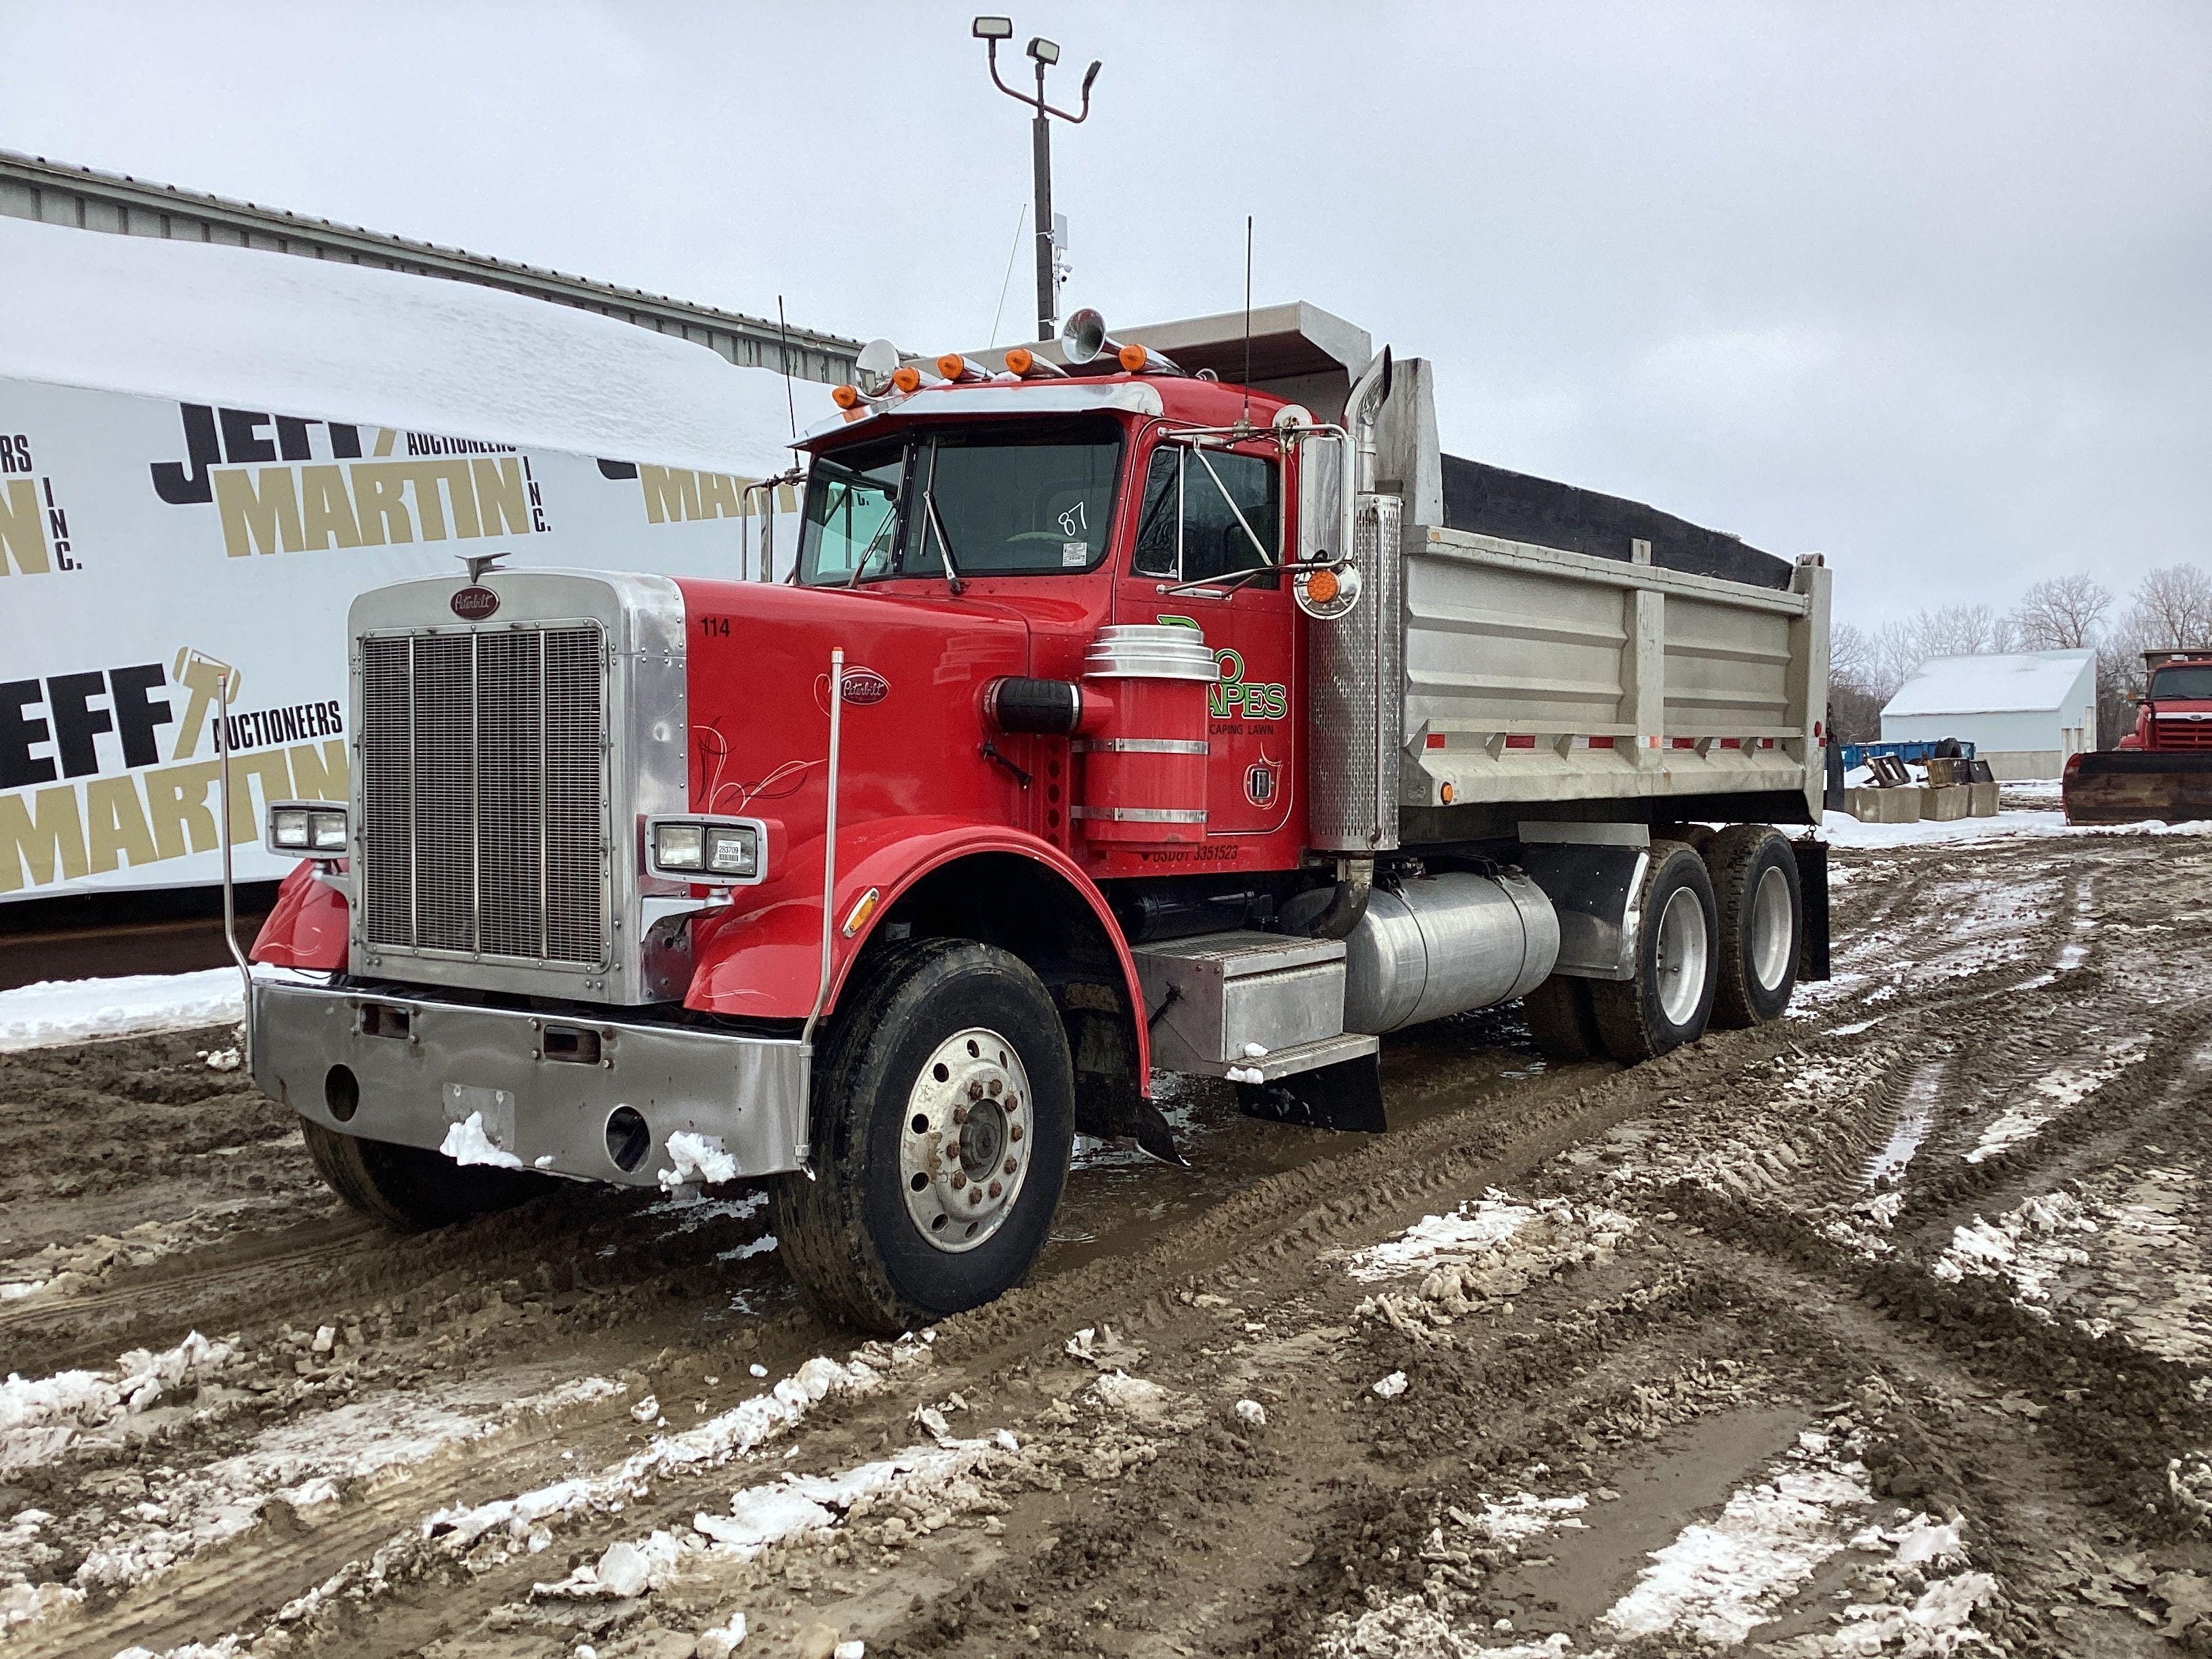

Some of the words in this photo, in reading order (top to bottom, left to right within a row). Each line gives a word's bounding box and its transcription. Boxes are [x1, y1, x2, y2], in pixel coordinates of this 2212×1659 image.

[213, 457, 530, 557] MARTIN
[1058, 501, 1087, 536] 87
[455, 594, 493, 611] Peterbilt
[701, 617, 730, 638] 114
[844, 680, 884, 696] Peterbilt
[1210, 682, 1287, 720] APES
[0, 663, 173, 789] EFF
[1209, 724, 1243, 735] CAPING
[1248, 724, 1274, 735] LAWN
[719, 846, 738, 854] 283709
[1193, 845, 1237, 861] 3351523
